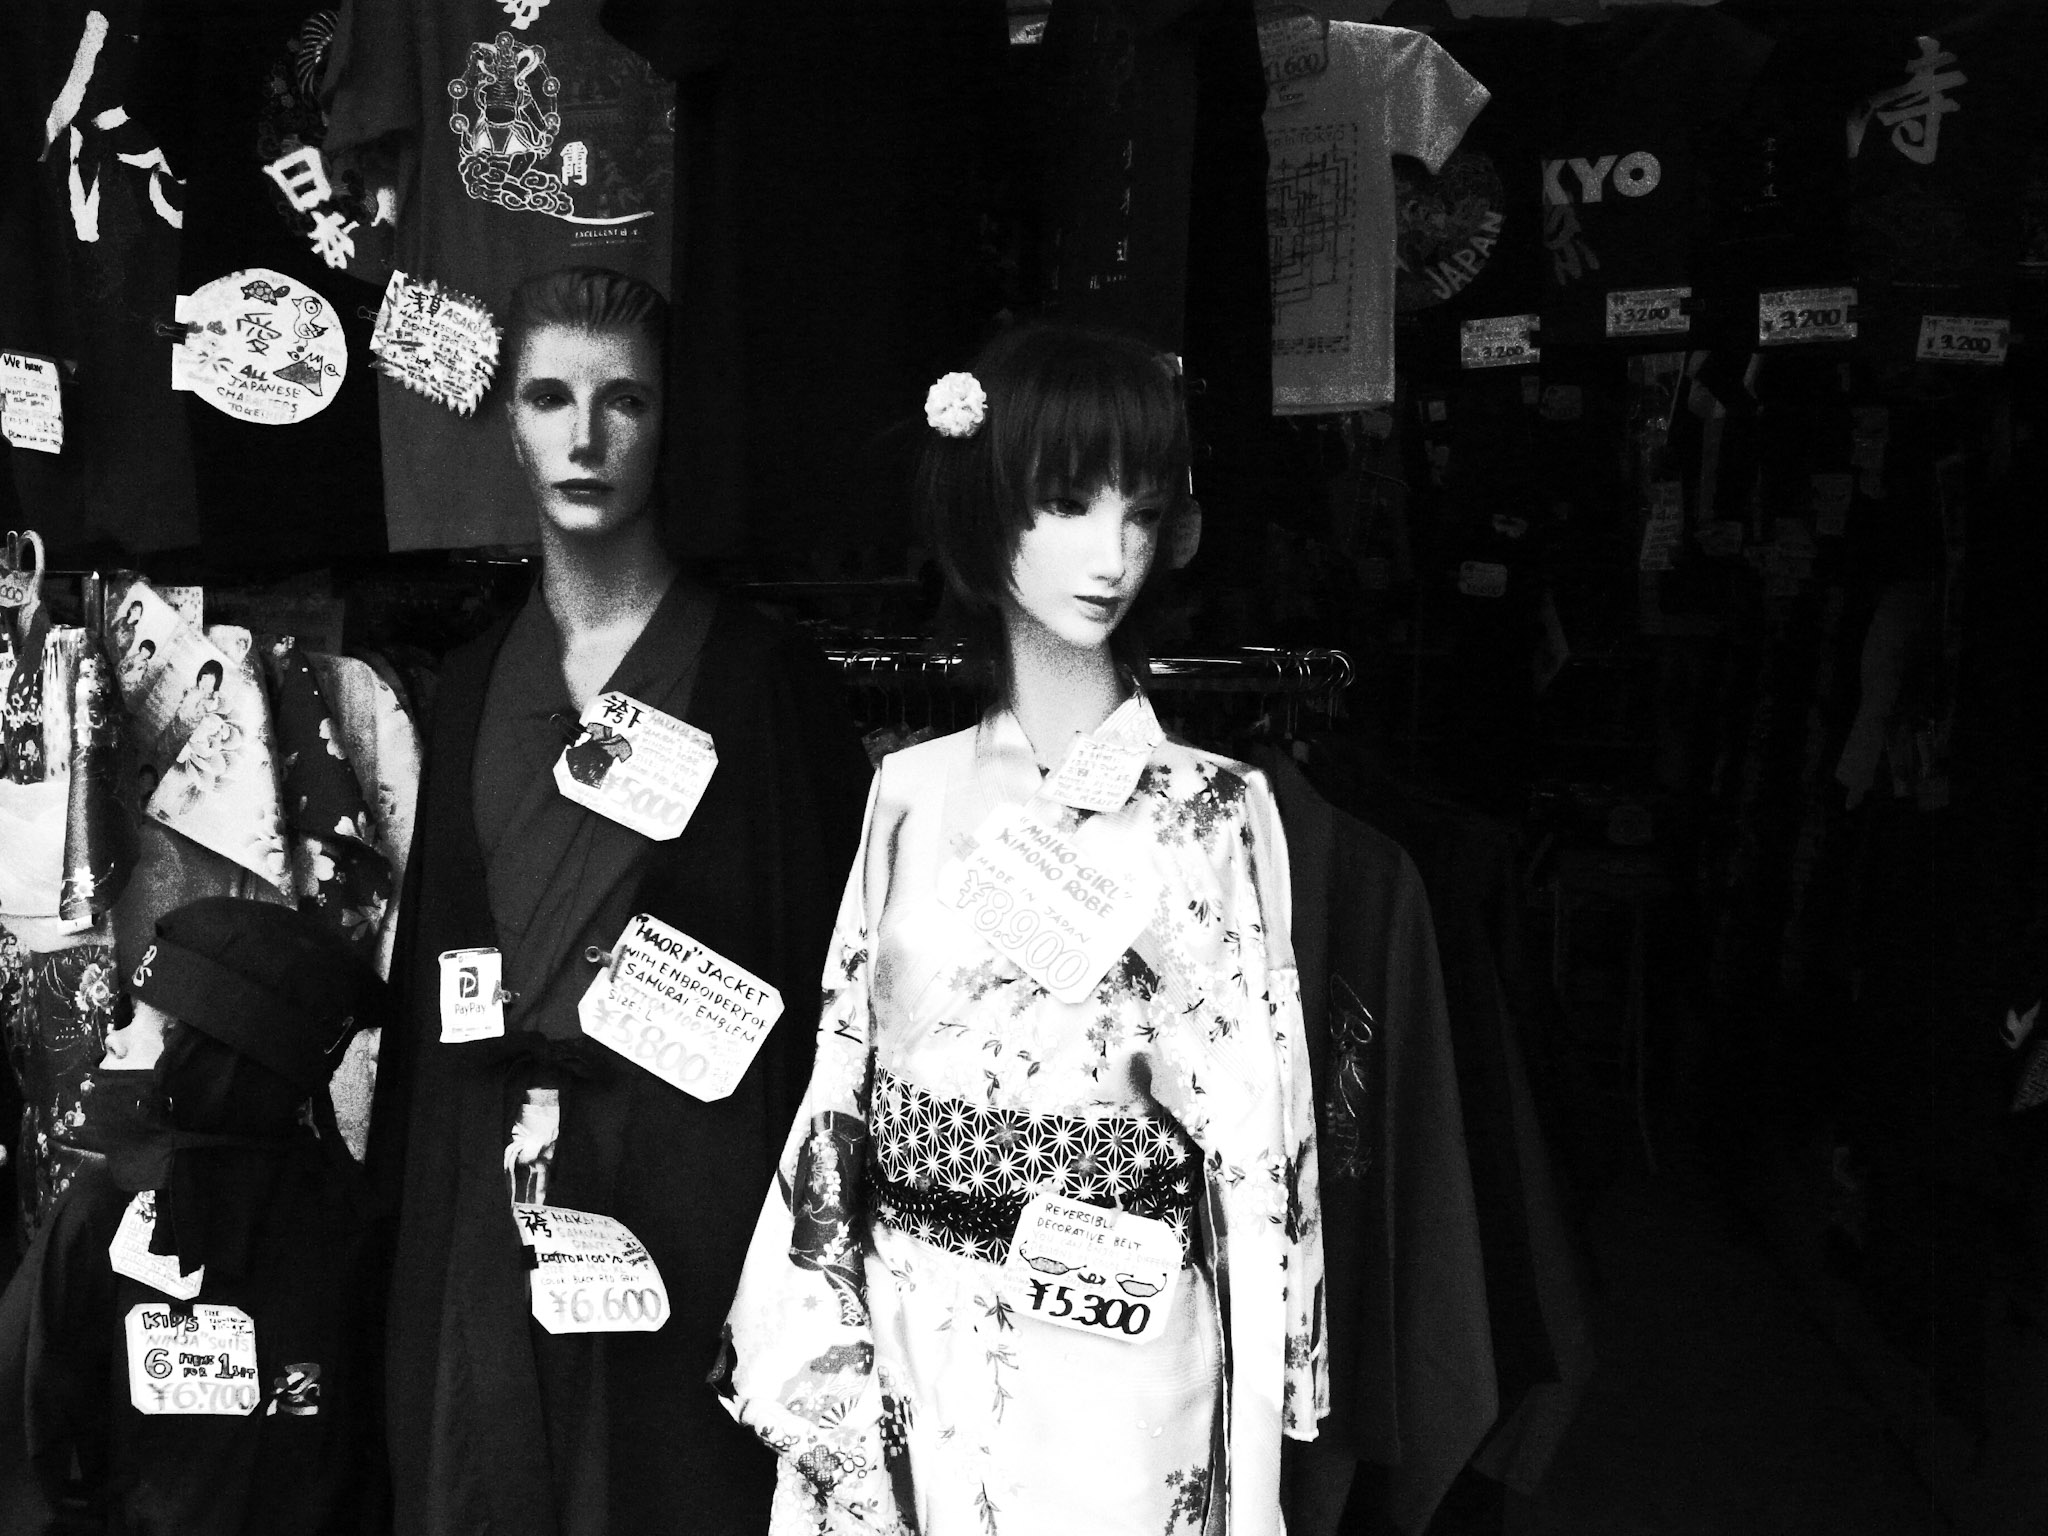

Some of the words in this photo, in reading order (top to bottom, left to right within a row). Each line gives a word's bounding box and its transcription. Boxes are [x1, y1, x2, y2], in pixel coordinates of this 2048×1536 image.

[1424, 210, 1505, 300] JAPAN
[3, 354, 21, 369] We
[239, 364, 269, 382] ALL
[227, 374, 301, 399] JAPANESE
[997, 827, 1064, 882] KIMONO
[1062, 878, 1114, 919] ROBE
[976, 855, 1015, 886] MADE
[1019, 887, 1037, 903] IN
[1043, 904, 1093, 945] JAPAN
[623, 947, 656, 969] WITH
[624, 962, 690, 1006] SAMURAI
[697, 959, 770, 1006] JACKET
[454, 1002, 487, 1016] PayPay
[1036, 1217, 1105, 1244] DECORATIVE
[1113, 1235, 1143, 1252] BELT
[142, 1310, 200, 1333] KIDS
[144, 1348, 173, 1379] 6
[214, 1352, 232, 1379] 1
